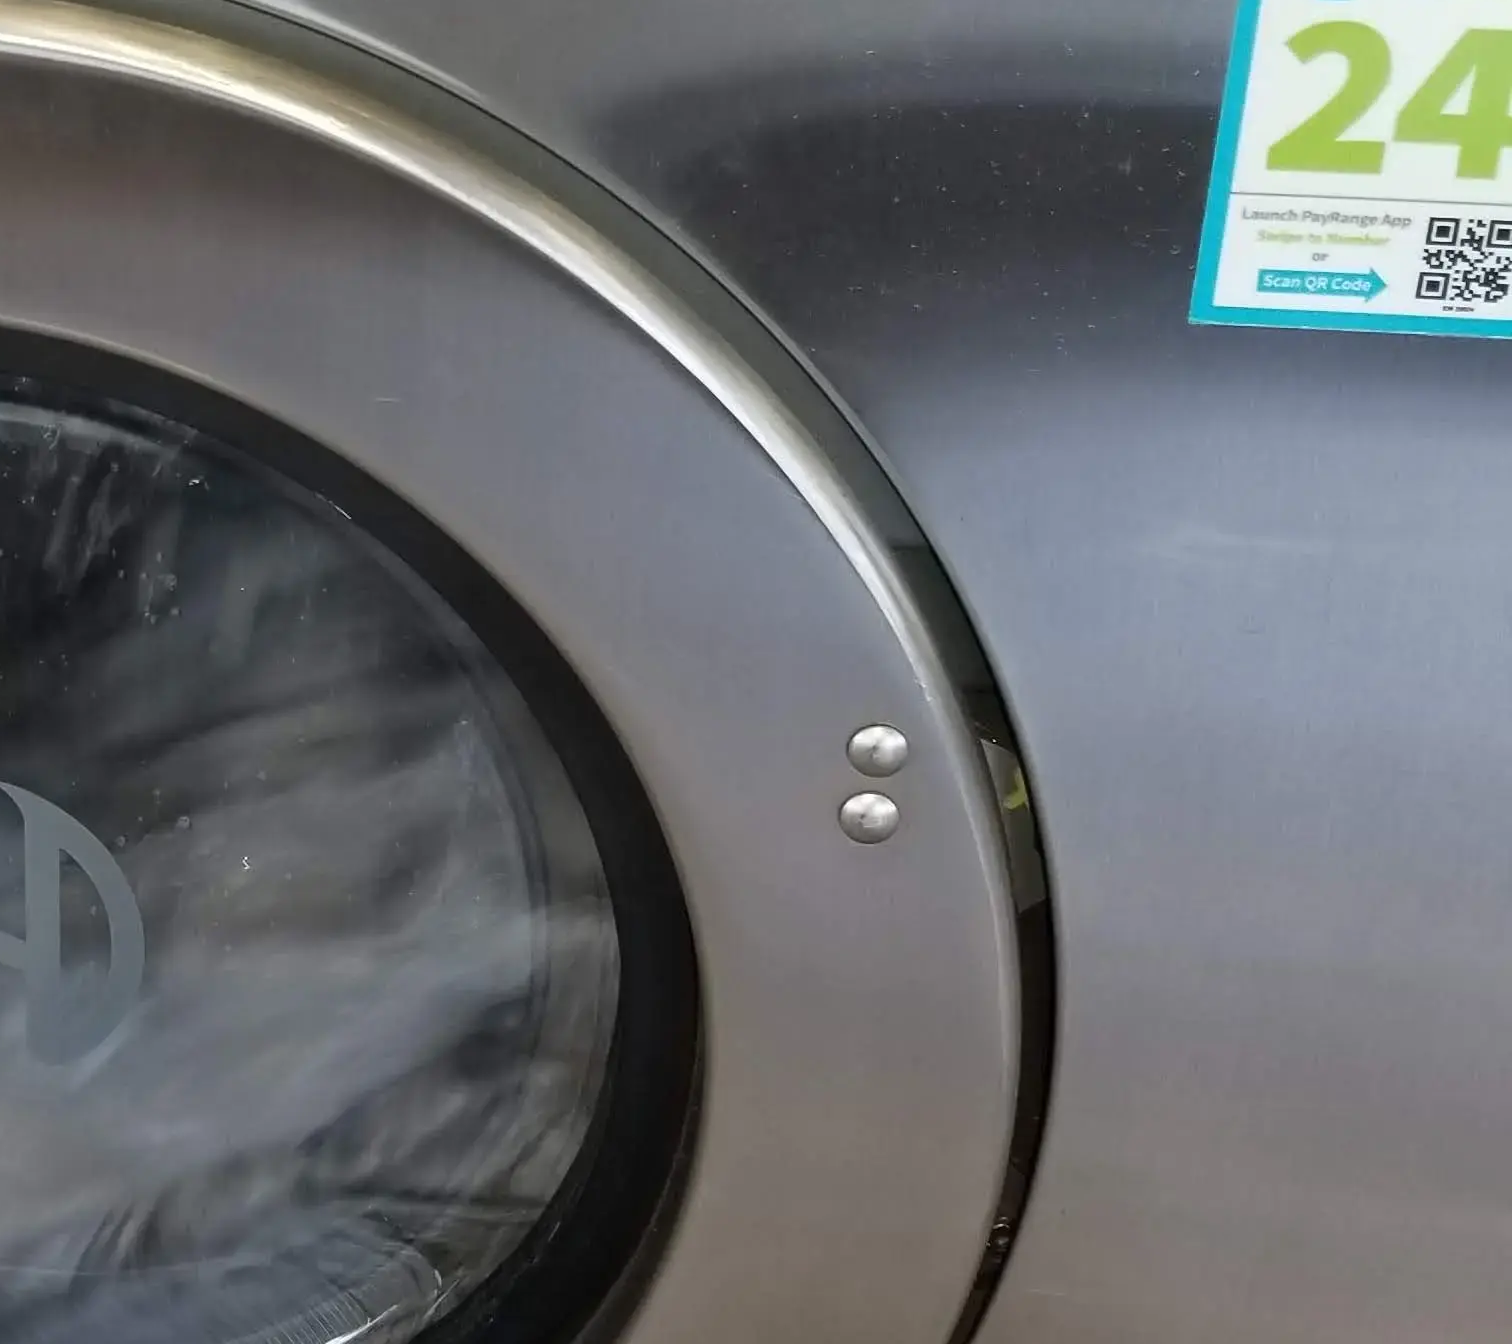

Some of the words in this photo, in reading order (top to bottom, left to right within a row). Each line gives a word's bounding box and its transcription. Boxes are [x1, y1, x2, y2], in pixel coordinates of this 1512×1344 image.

[1242, 208, 1298, 222] Launch
[1302, 210, 1378, 227] PayRange
[1381, 214, 1412, 229] App
[1312, 253, 1329, 262] or
[1263, 275, 1301, 287] Scan
[1304, 277, 1328, 291] QR
[1332, 278, 1372, 292] Code
